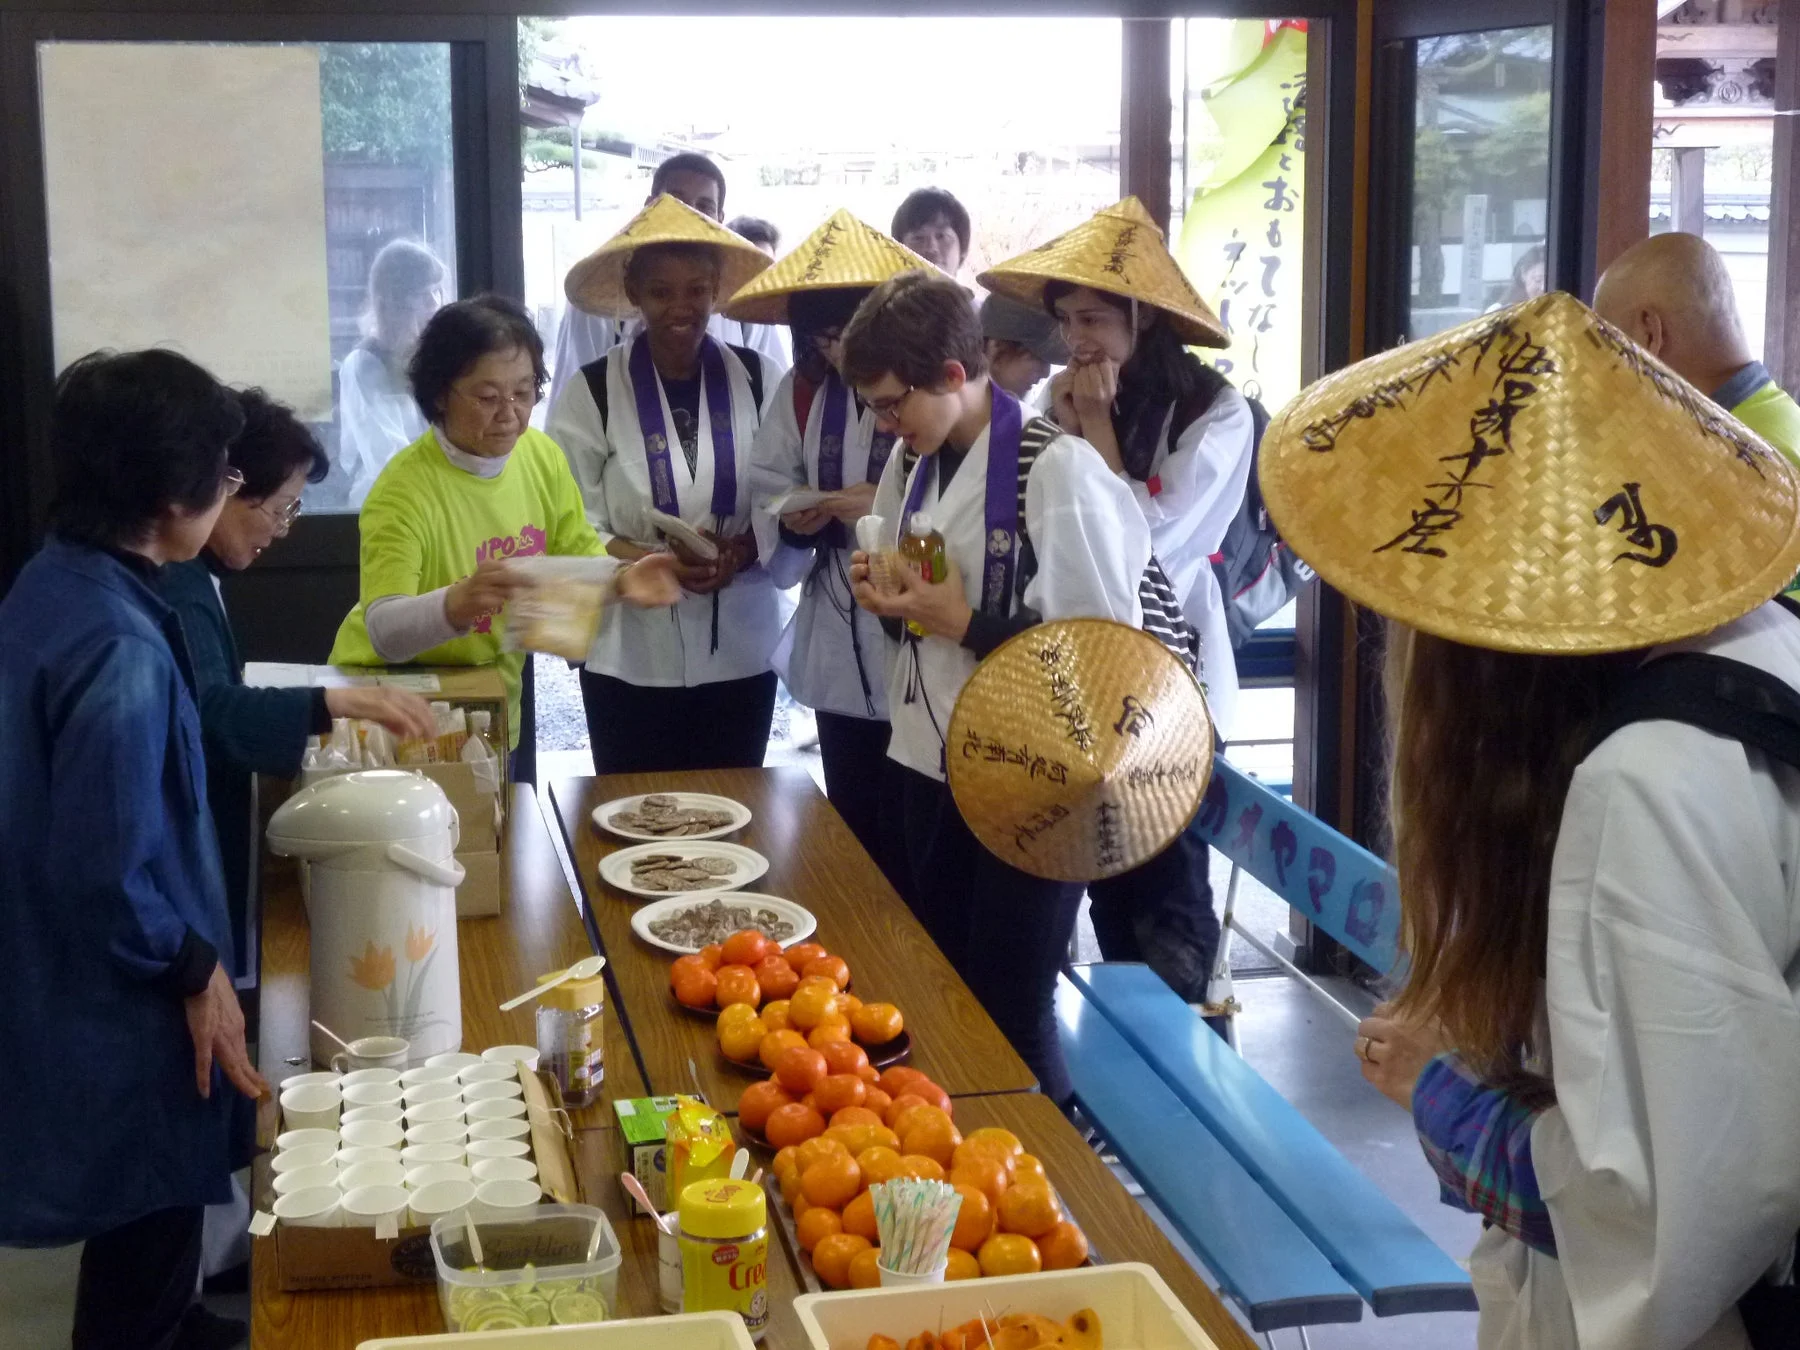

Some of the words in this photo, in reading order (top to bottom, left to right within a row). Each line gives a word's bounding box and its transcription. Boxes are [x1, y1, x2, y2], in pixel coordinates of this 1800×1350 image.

[1199, 772, 1401, 948] カメヤマロ
